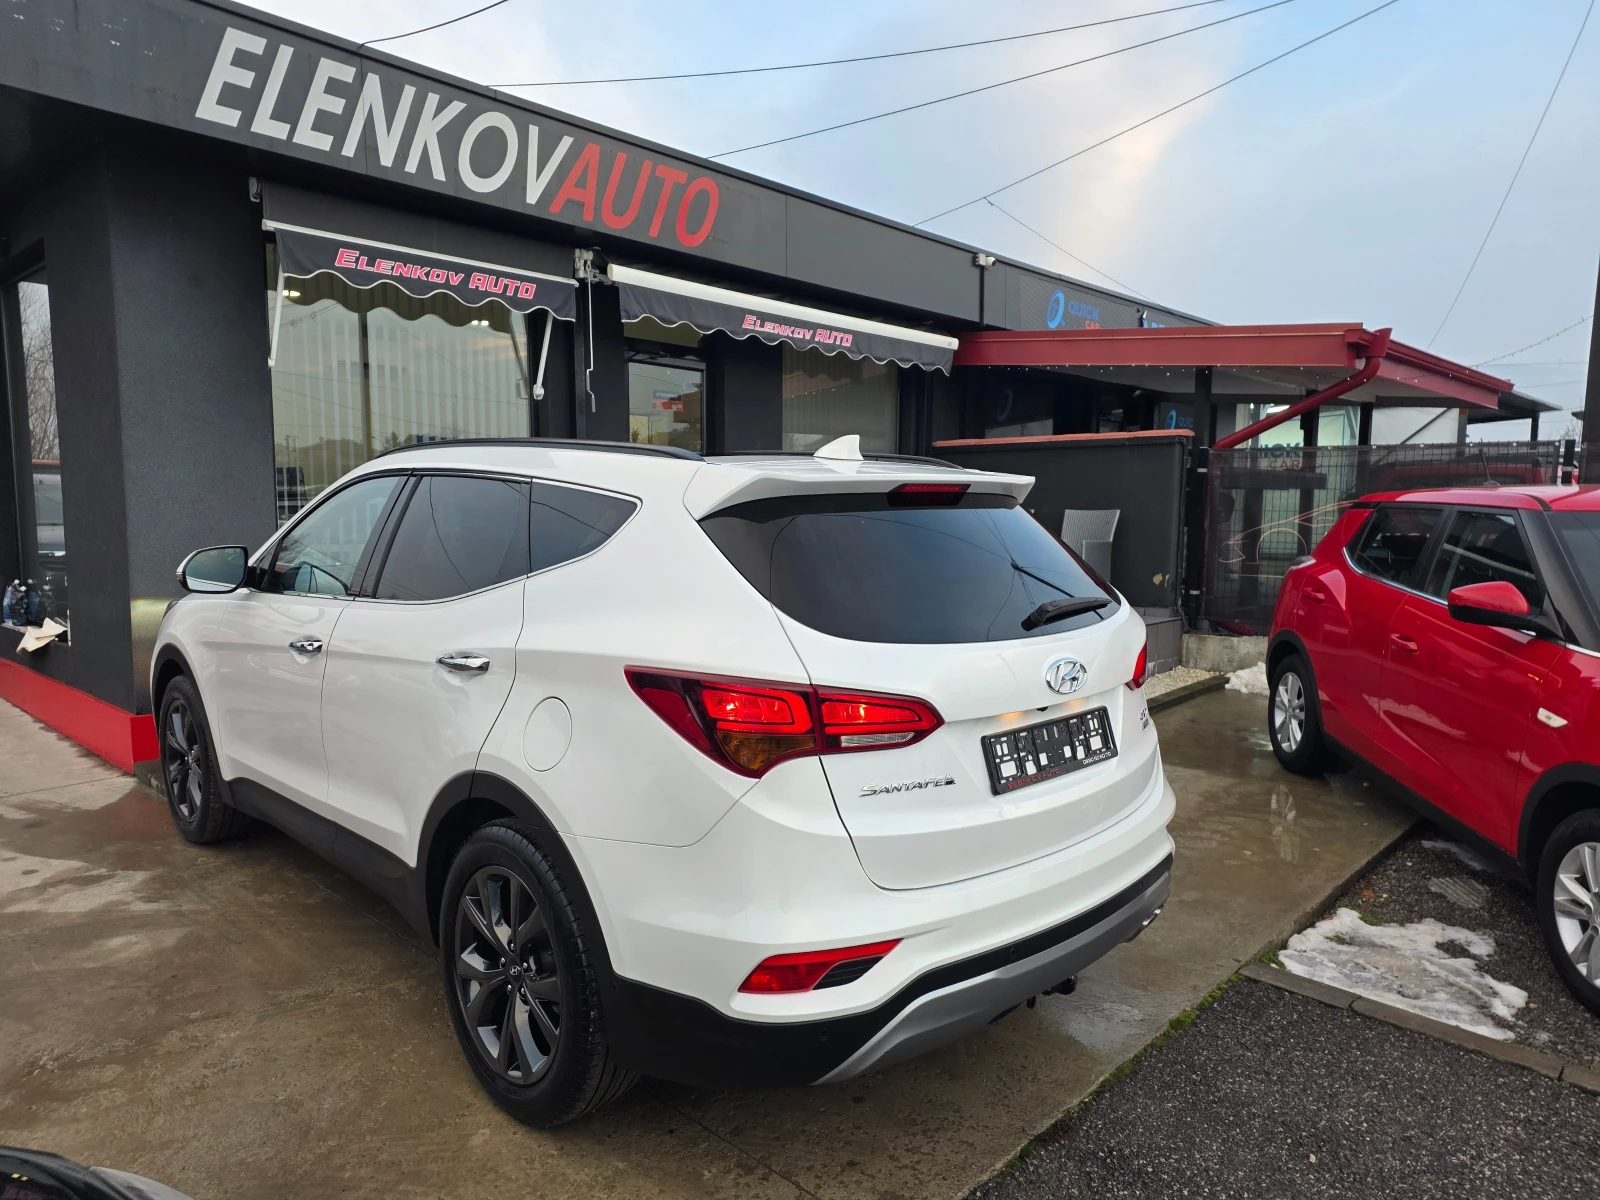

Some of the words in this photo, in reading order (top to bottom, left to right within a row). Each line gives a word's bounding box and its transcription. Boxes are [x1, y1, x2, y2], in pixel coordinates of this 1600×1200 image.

[334, 247, 465, 286] ELENKOV
[468, 272, 537, 300] AUTO
[1068, 300, 1100, 321] QUICK
[742, 314, 814, 341] ELENKOV
[815, 328, 853, 347] AUTO
[1177, 416, 1194, 429] QUIC
